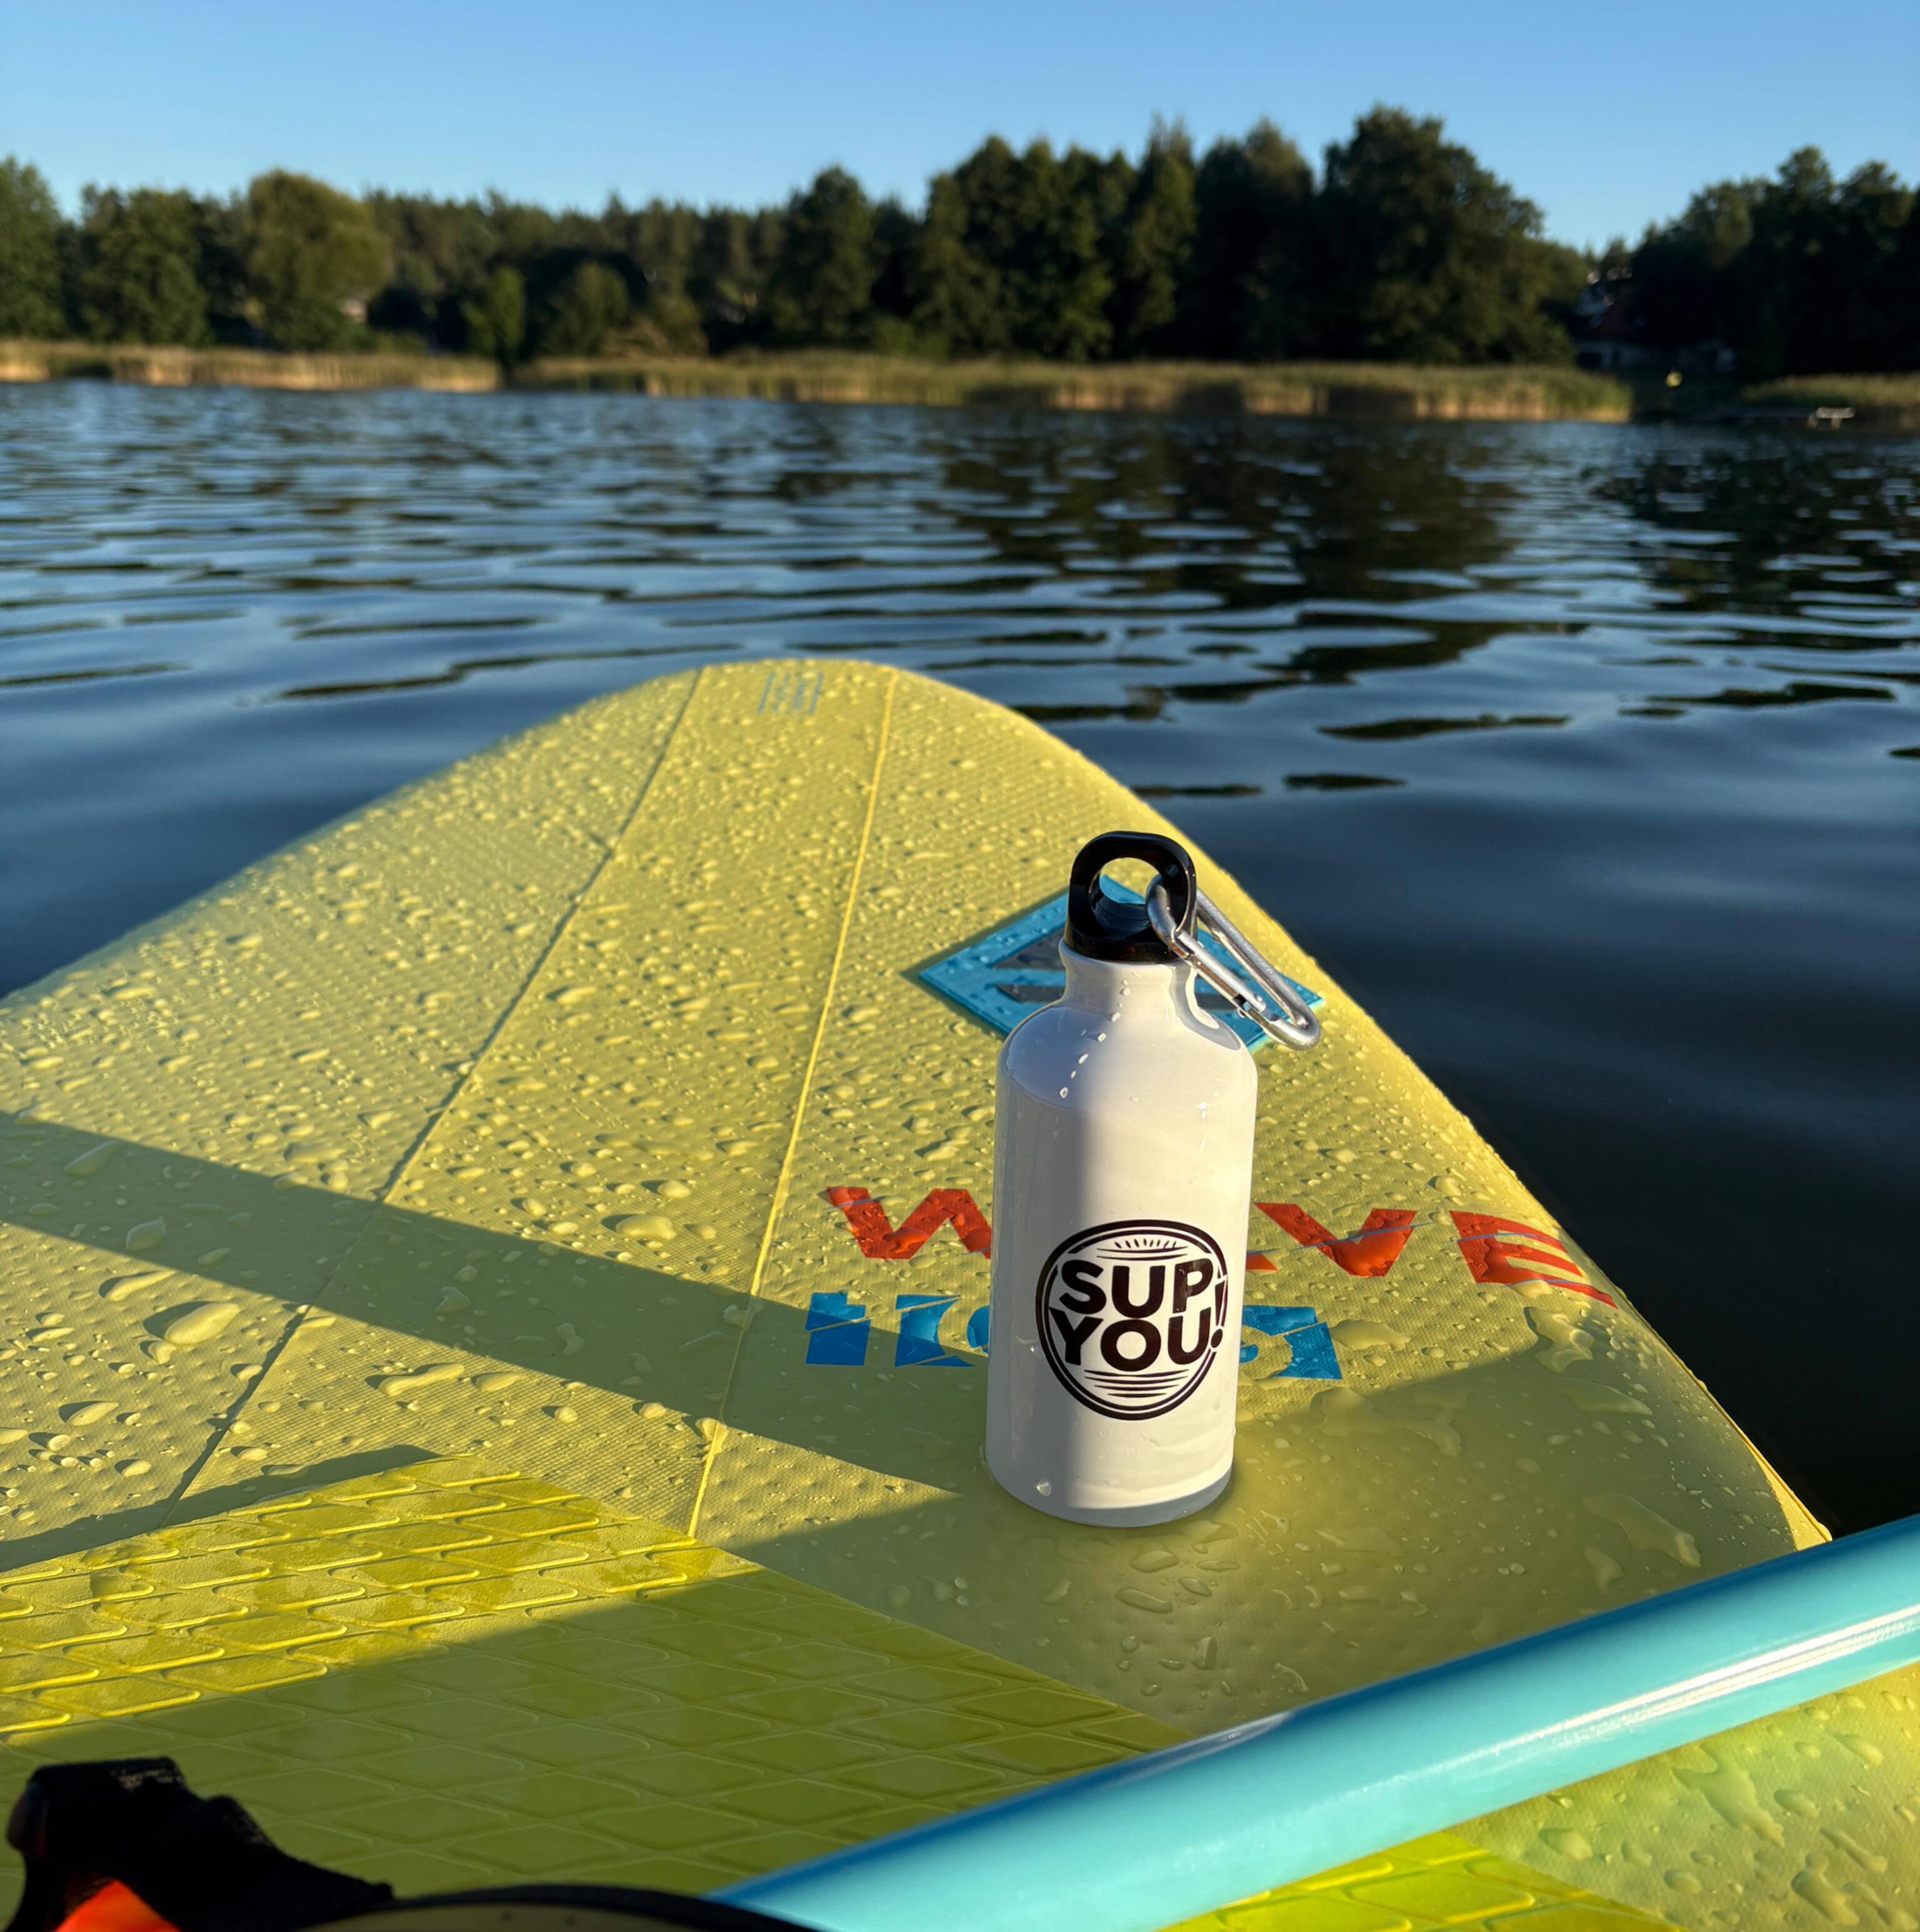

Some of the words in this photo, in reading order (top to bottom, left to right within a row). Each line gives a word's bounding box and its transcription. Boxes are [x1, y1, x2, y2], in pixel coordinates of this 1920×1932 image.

[826, 1186, 1619, 1310] WVE
[1059, 1258, 1214, 1318] SUP
[1048, 1281, 1223, 1372] YOU!
